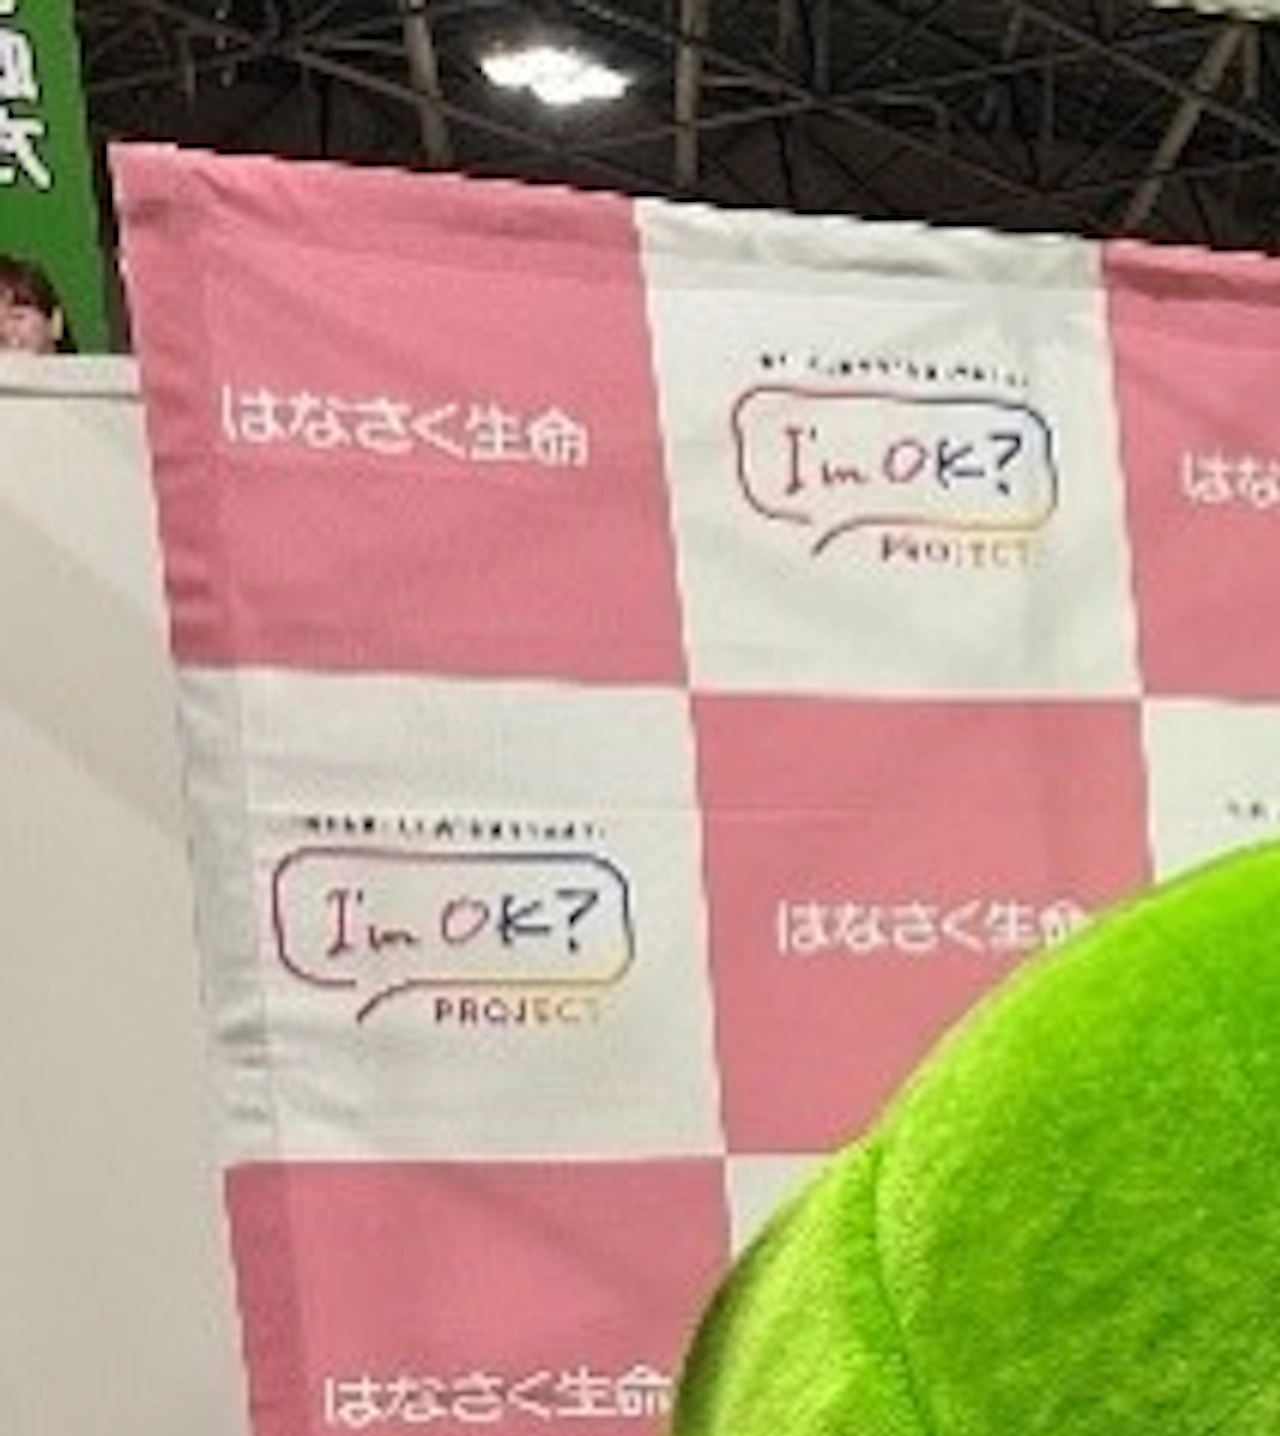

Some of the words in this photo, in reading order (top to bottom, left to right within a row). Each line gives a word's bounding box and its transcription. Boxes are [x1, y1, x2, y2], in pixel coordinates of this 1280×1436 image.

[220, 384, 590, 468] はなさく生命
[325, 887, 419, 960] I'm
[440, 889, 600, 954] OK?
[323, 1362, 673, 1428] はなさく生命
